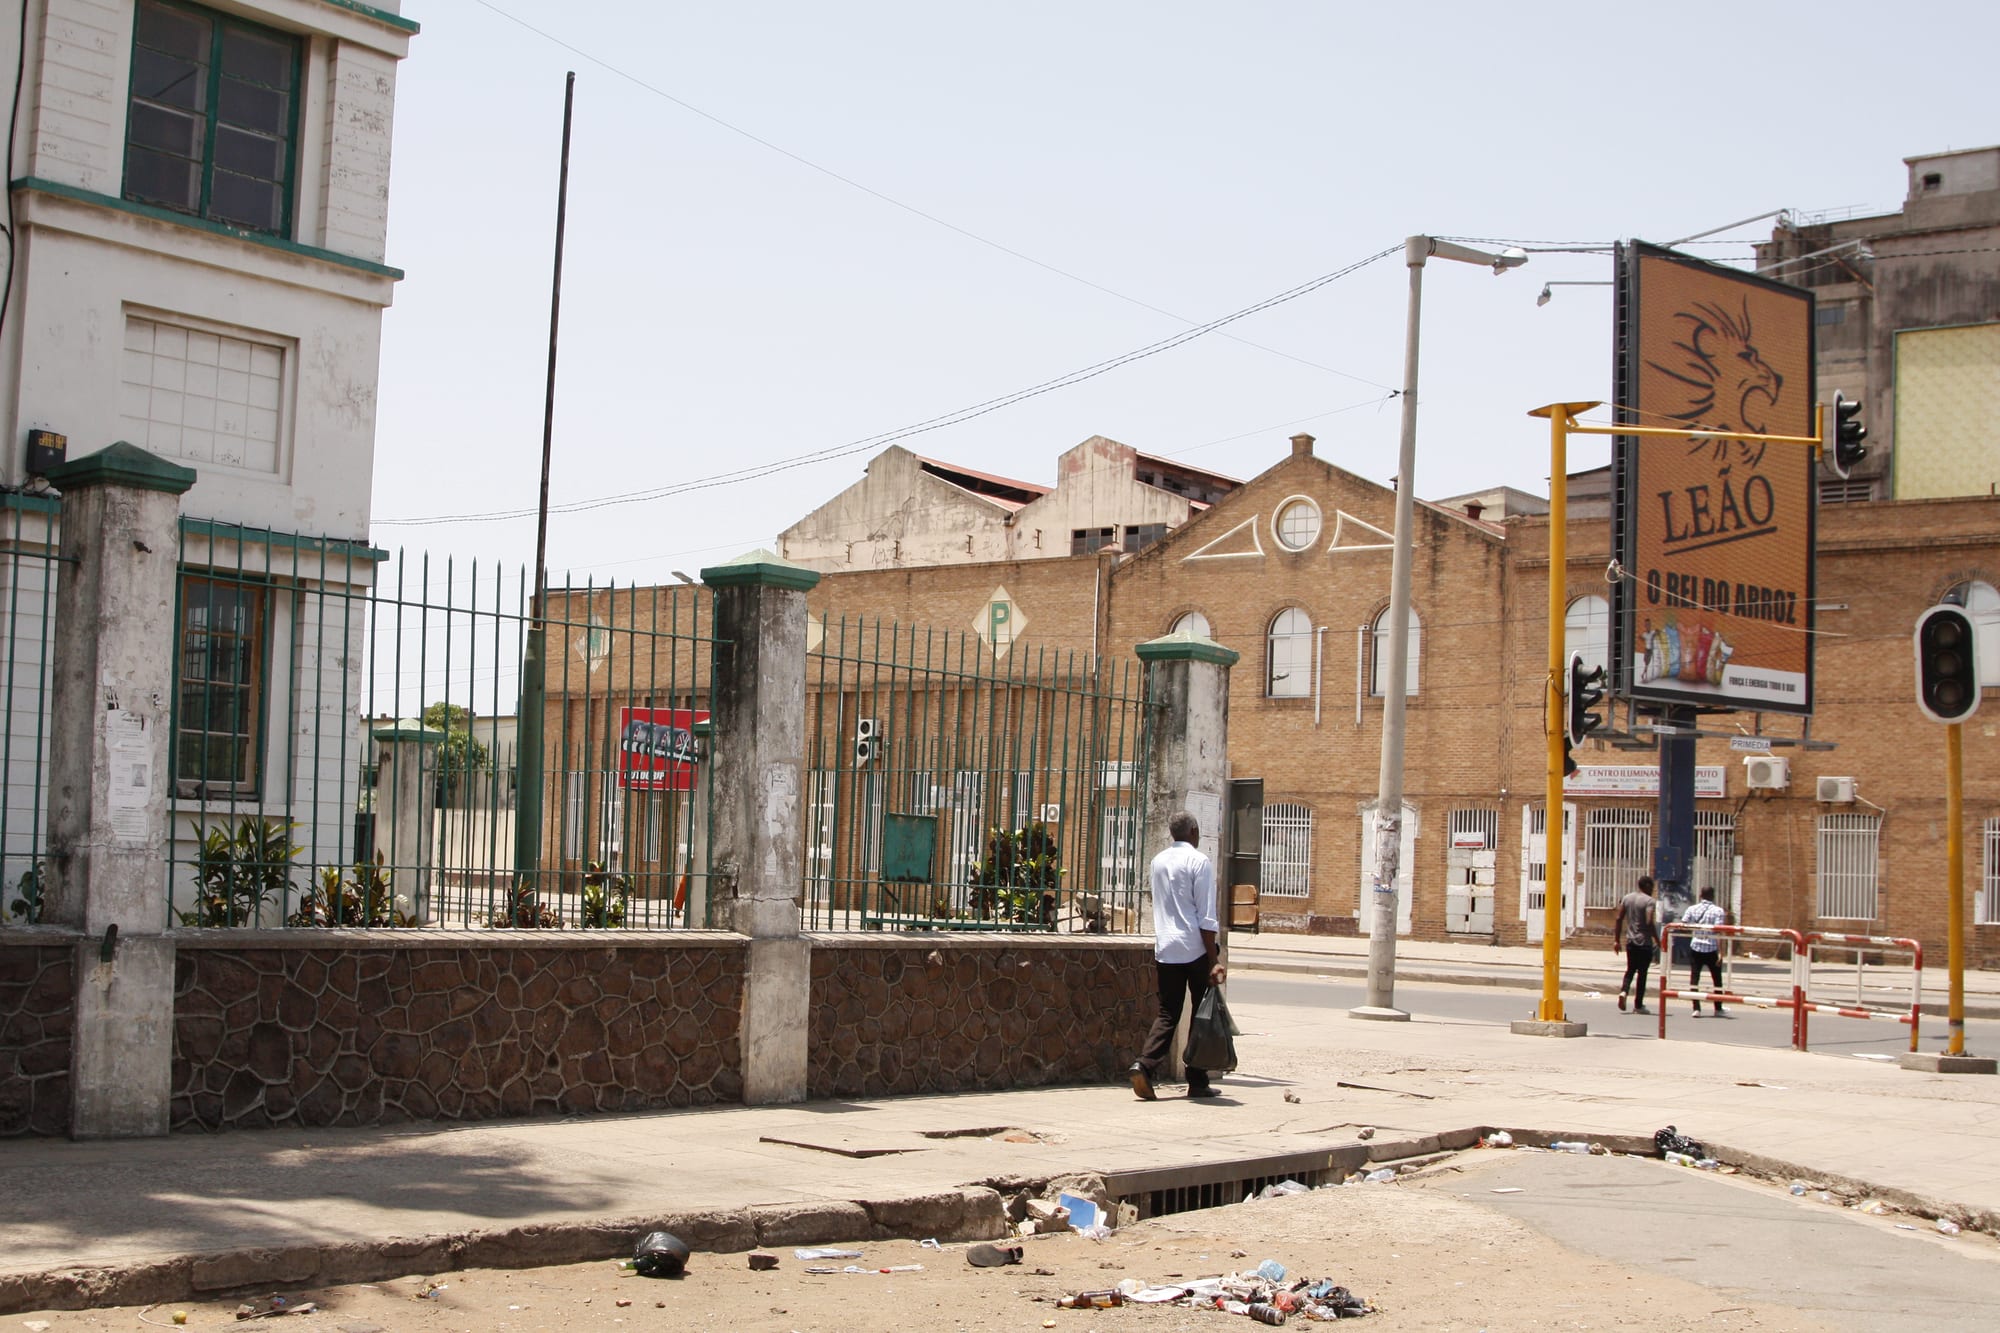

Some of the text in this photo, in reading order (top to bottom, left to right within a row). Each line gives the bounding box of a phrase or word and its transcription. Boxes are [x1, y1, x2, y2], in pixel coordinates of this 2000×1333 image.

[1658, 464, 1775, 544] LEÃO
[1647, 568, 1797, 625] O REI DO ARROZ
[991, 603, 1009, 641] P
[1732, 739, 1769, 749] PRIMEDIA
[1588, 769, 1718, 778] CENTRO ILUMINAN PUTO
